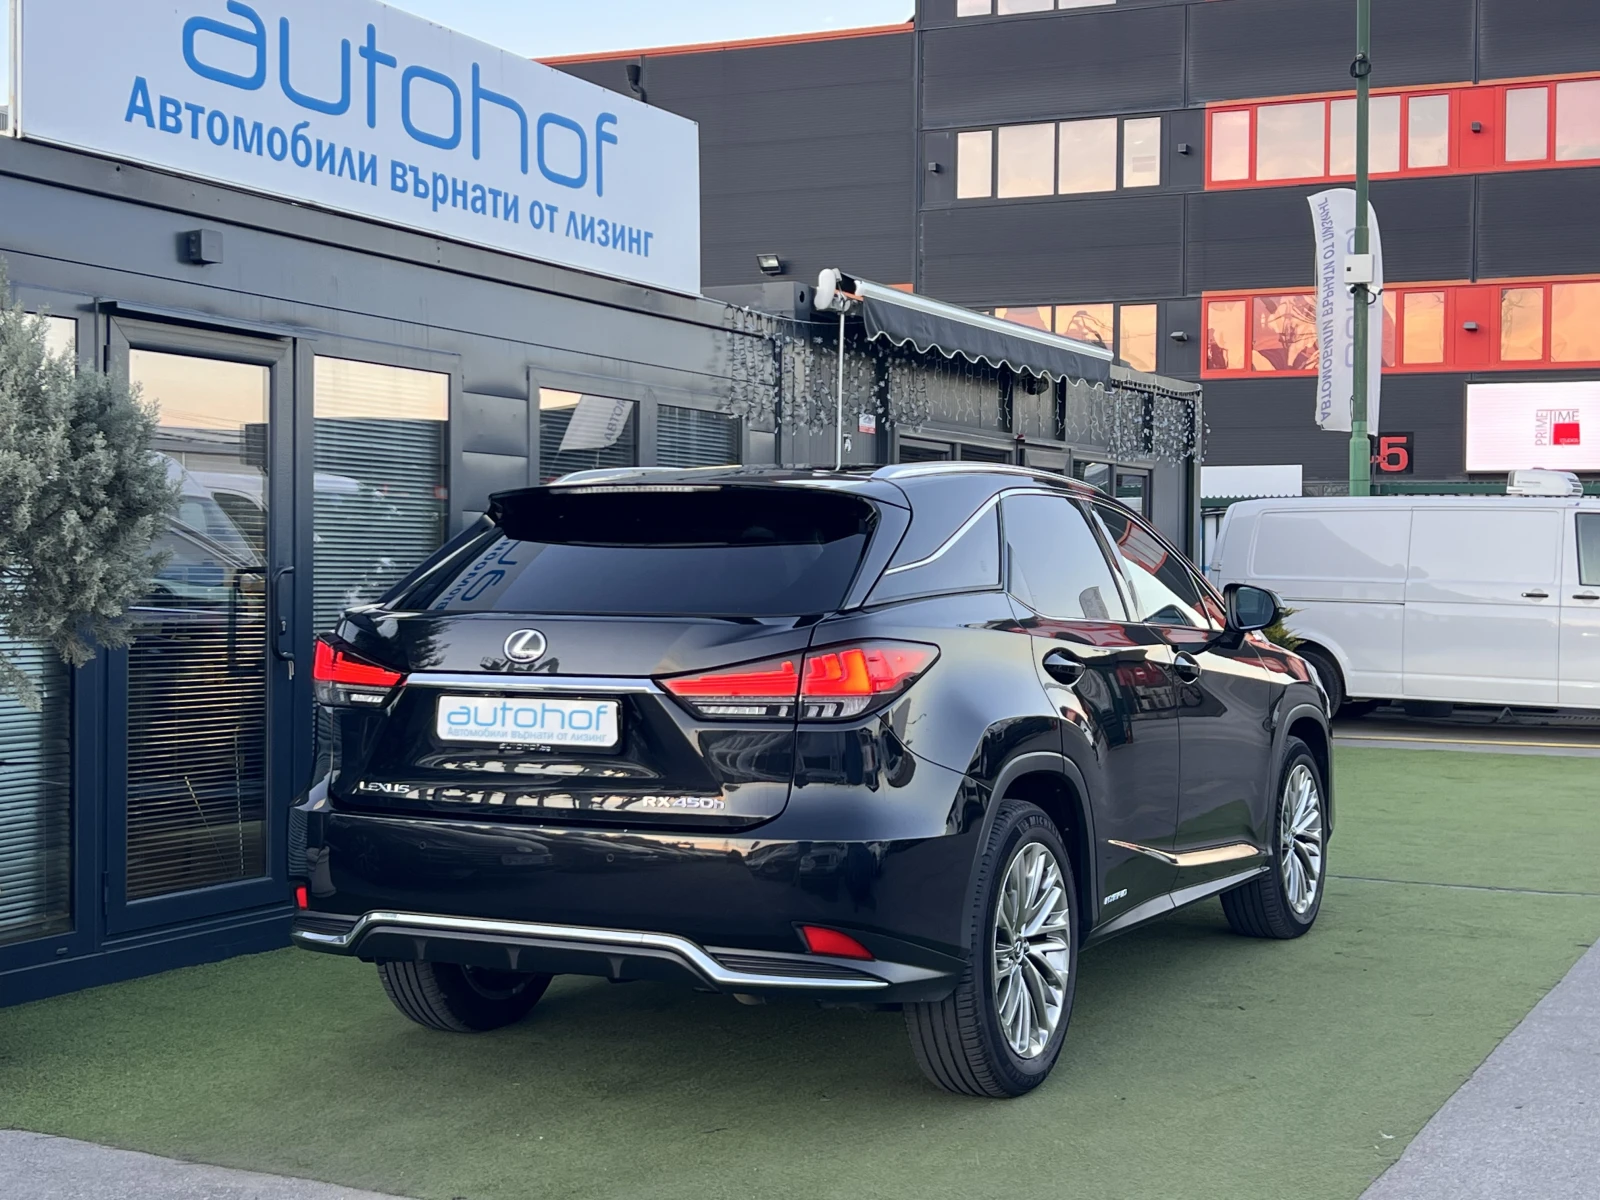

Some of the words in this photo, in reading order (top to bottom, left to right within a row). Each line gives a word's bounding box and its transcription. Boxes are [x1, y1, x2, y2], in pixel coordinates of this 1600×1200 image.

[182, 0, 618, 197] autohof
[124, 75, 378, 187] Автомобили
[389, 159, 520, 223] върнати
[528, 200, 559, 233] от
[564, 211, 653, 256] лизинг
[1535, 410, 1548, 446] PRIME
[1380, 437, 1409, 472] 5
[447, 701, 609, 731] autohof
[447, 727, 508, 738] Автомобили
[511, 730, 554, 741] върнати
[556, 732, 568, 741] от
[571, 733, 608, 743] лизинг
[359, 780, 411, 794] LEXUS
[642, 795, 671, 808] RX
[672, 796, 726, 810] 450h
